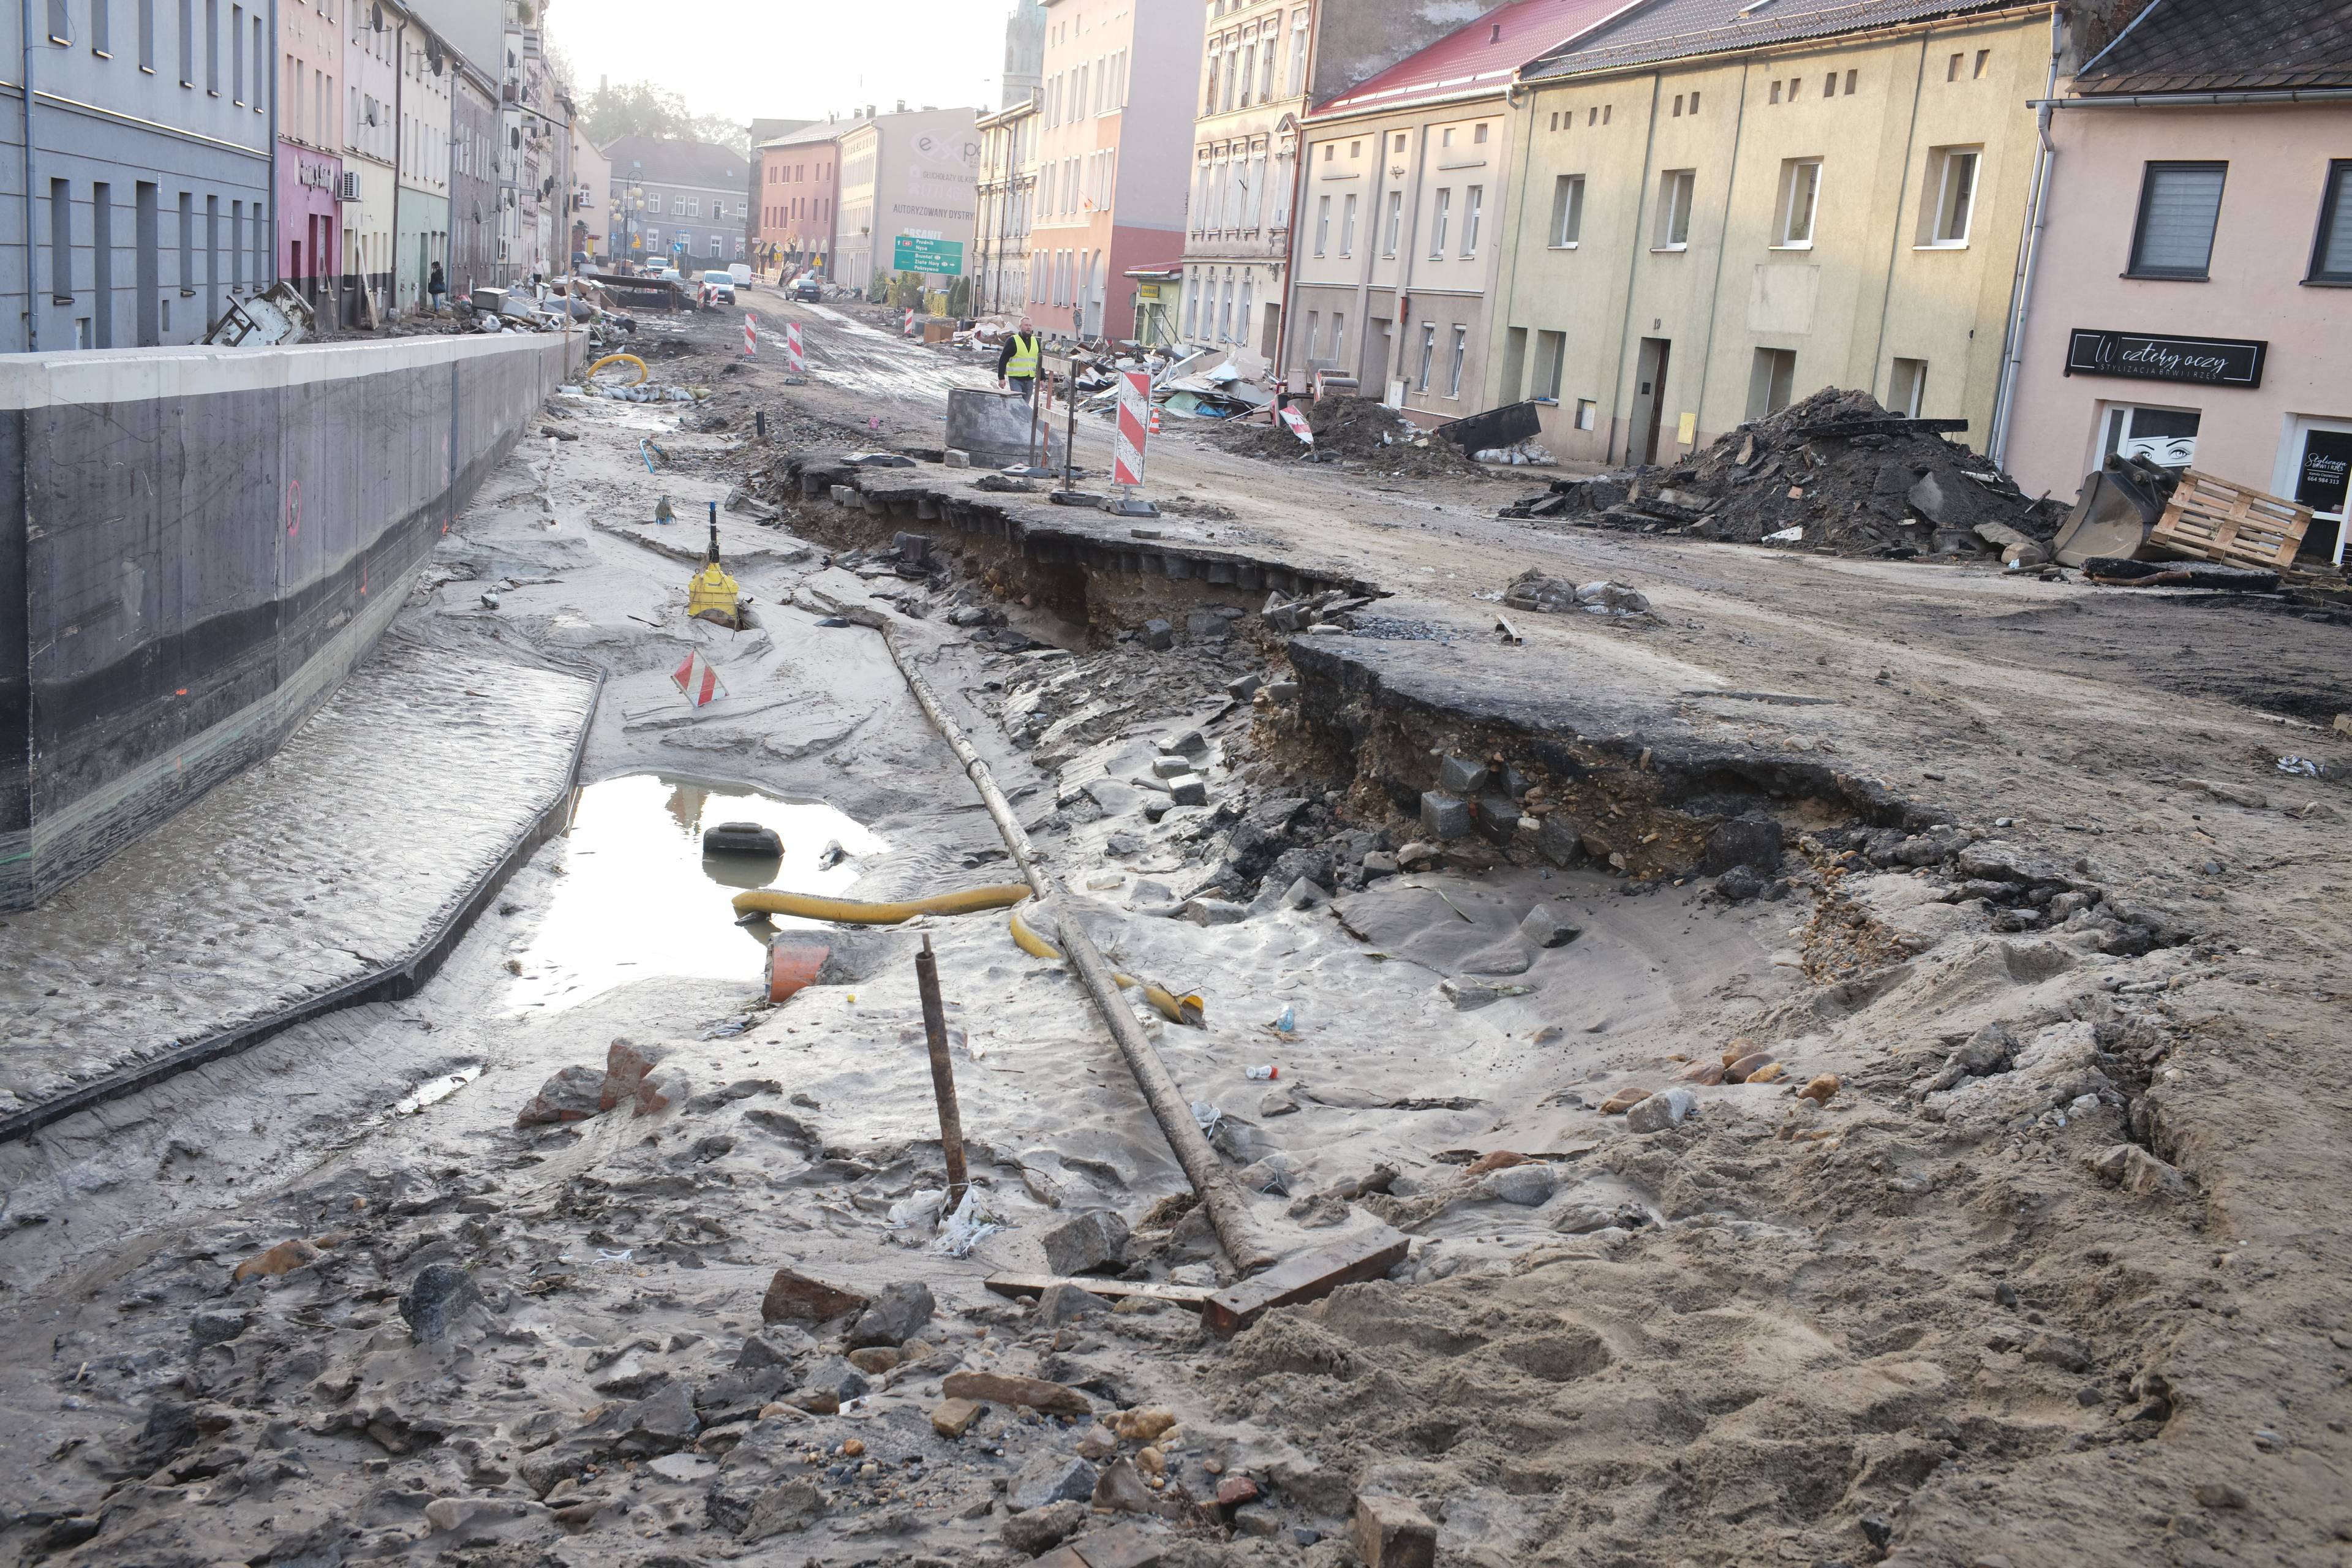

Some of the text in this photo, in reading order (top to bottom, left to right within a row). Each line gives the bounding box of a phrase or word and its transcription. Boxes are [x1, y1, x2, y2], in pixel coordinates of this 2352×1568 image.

[923, 172, 956, 181] GŁUCHOŁAZY
[893, 204, 948, 218] AUTORYZOWANY
[1653, 318, 1661, 330] 19
[2095, 334, 2230, 373] W cztery oczy
[2100, 364, 2157, 374] STYLIZACJA
[2159, 368, 2184, 377] BRWI
[2193, 372, 2217, 381] RZĘS
[2304, 453, 2348, 467] Stylizacja
